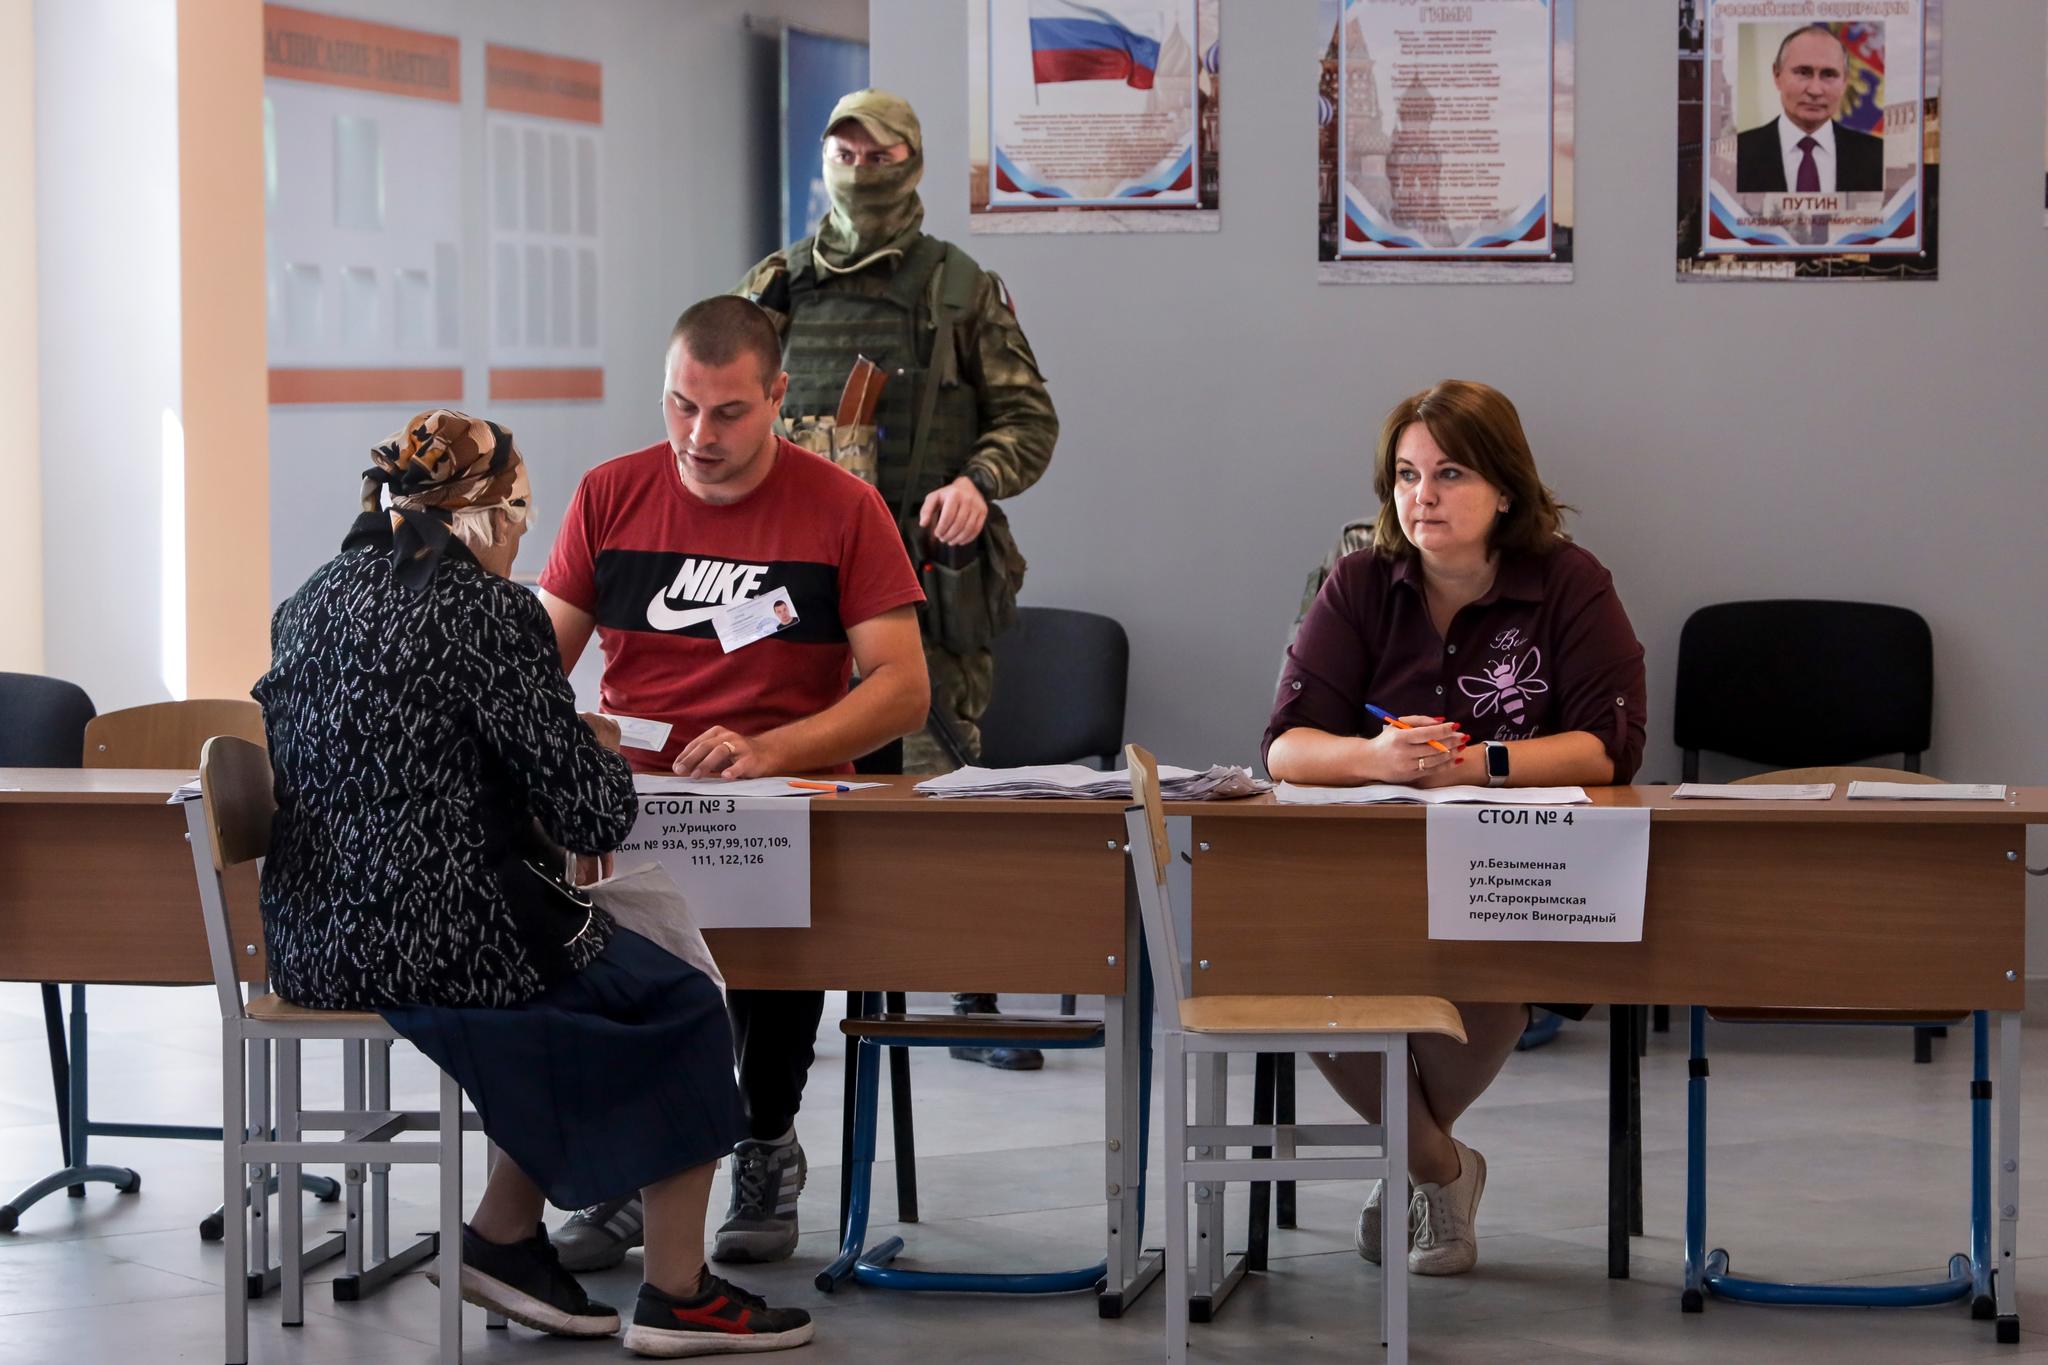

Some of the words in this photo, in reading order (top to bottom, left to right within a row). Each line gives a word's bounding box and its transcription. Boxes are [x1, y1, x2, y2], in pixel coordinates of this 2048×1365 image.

[1419, 6, 1473, 23] ГИМН
[264, 29, 370, 77] АСПИСАНИЕ
[1782, 197, 1838, 210] ПУТИН
[666, 558, 769, 603] NIKE
[1490, 627, 1528, 650] Be
[1493, 724, 1540, 741] kind
[644, 800, 693, 816] СТОЛ
[699, 799, 721, 814] №
[725, 799, 736, 814] 3
[1478, 809, 1529, 825] СТОЛ
[1535, 810, 1557, 825] №
[1563, 811, 1574, 826] 4
[662, 822, 737, 836] ул.Урицкого
[644, 839, 659, 851] №
[662, 839, 688, 851] 93А,
[691, 837, 792, 851] 95,97,99,107,109,
[691, 855, 716, 867] 111,
[719, 854, 764, 866] 122,126
[1470, 858, 1567, 871] ул.Безыменная
[1470, 875, 1552, 889] ул.Крымская
[1469, 892, 1587, 907] ул.Старокрымская
[1469, 910, 1529, 923] переулок
[1532, 910, 1616, 925] Виноградный
